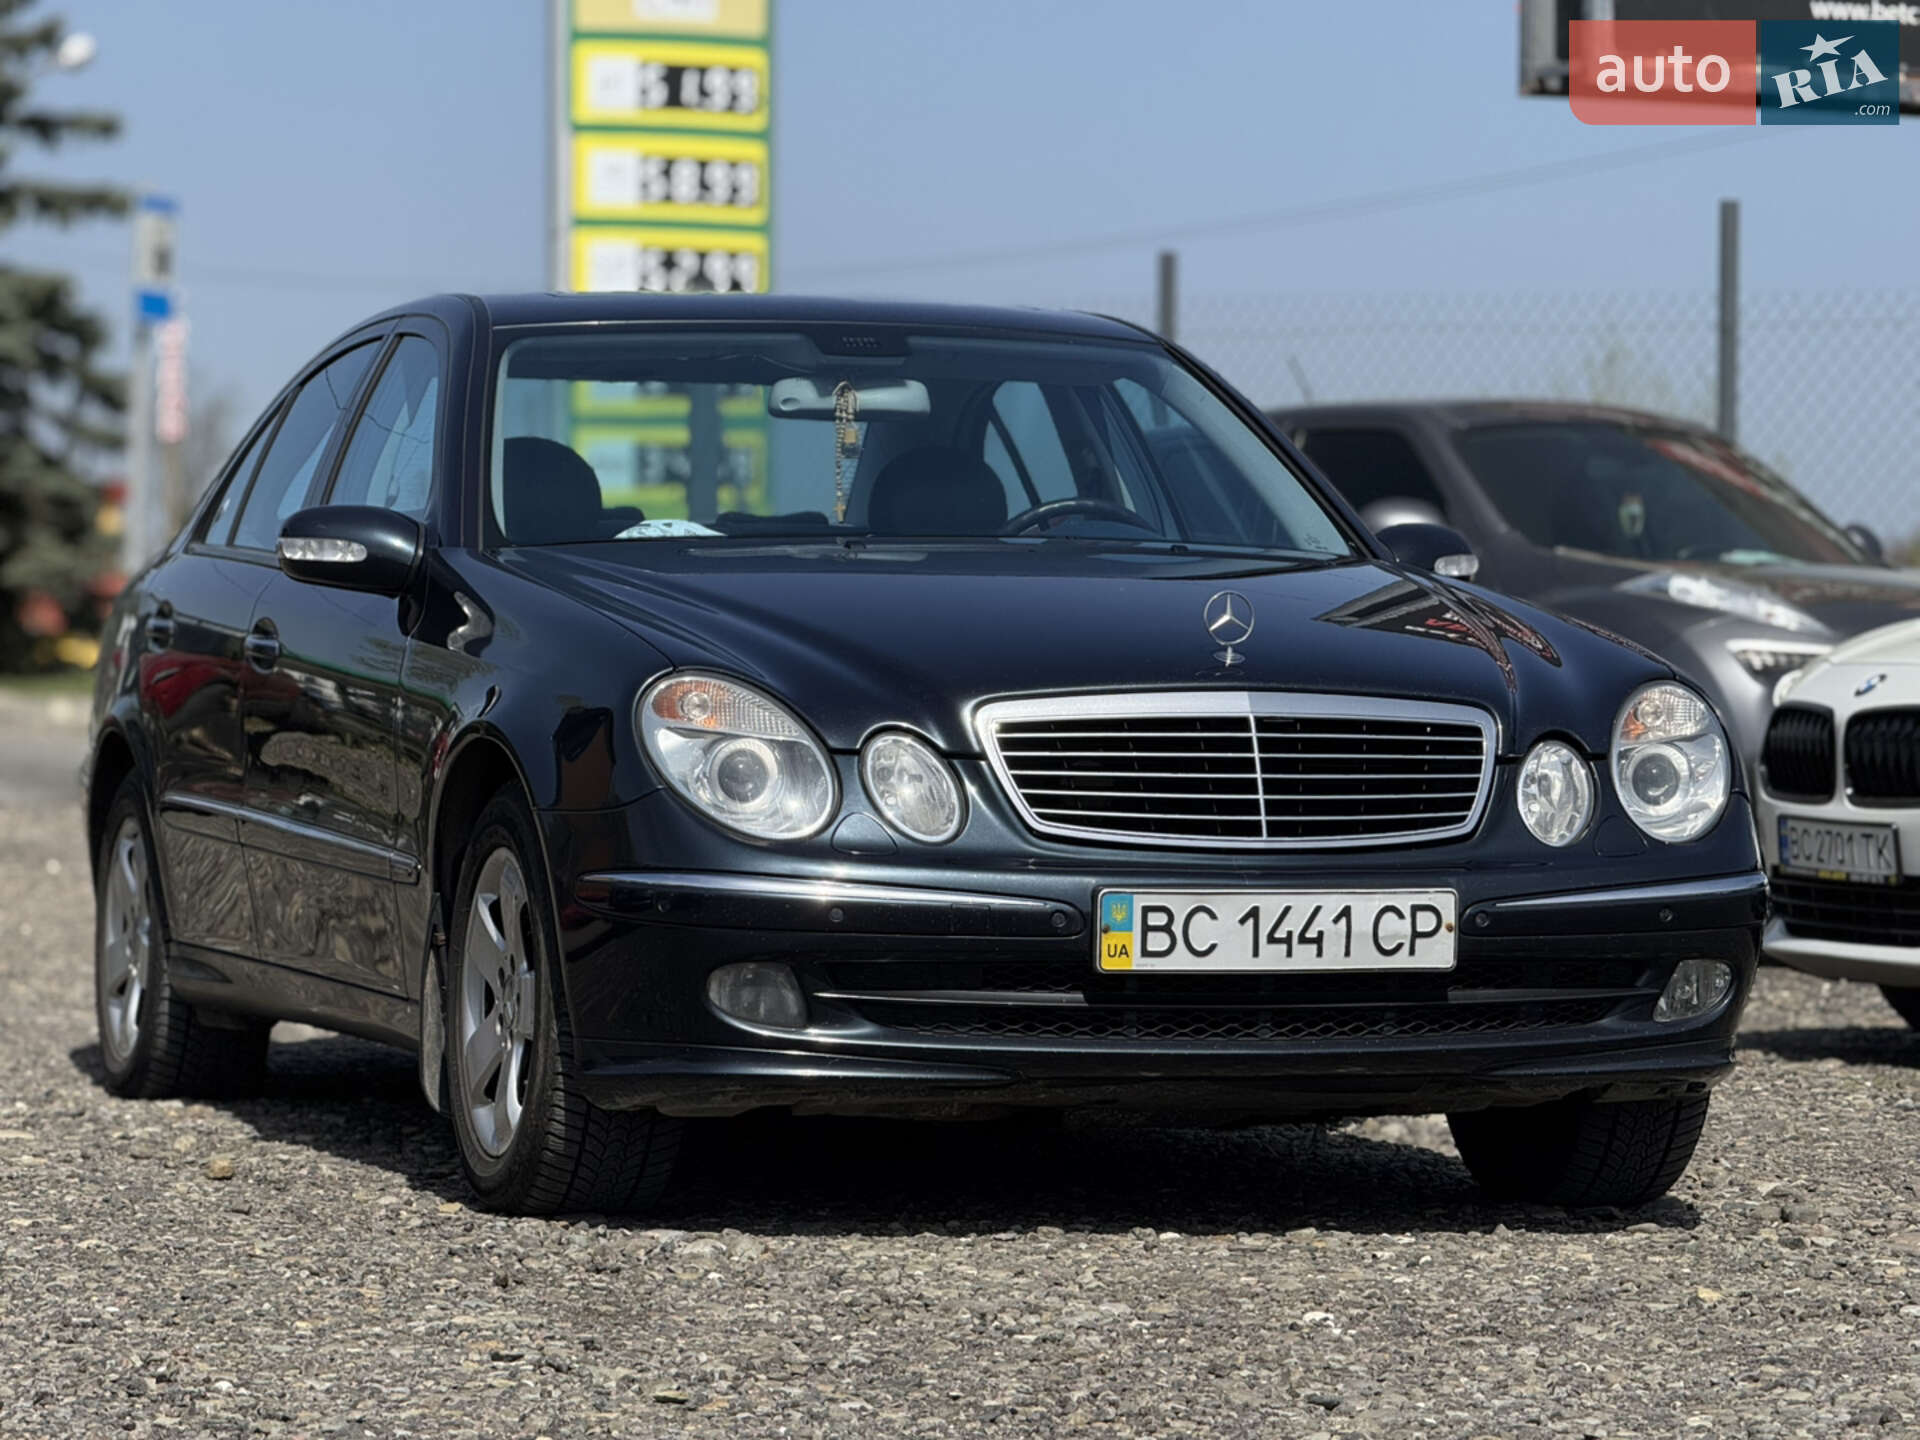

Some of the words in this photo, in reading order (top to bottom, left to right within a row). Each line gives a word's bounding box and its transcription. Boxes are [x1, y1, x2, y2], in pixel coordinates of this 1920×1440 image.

[1790, 826, 1812, 861] BC
[1861, 833, 1893, 870] TK
[1107, 943, 1130, 958] UA
[1140, 904, 1218, 958] BC
[1238, 904, 1351, 958] 1441
[1372, 903, 1443, 957] CP
